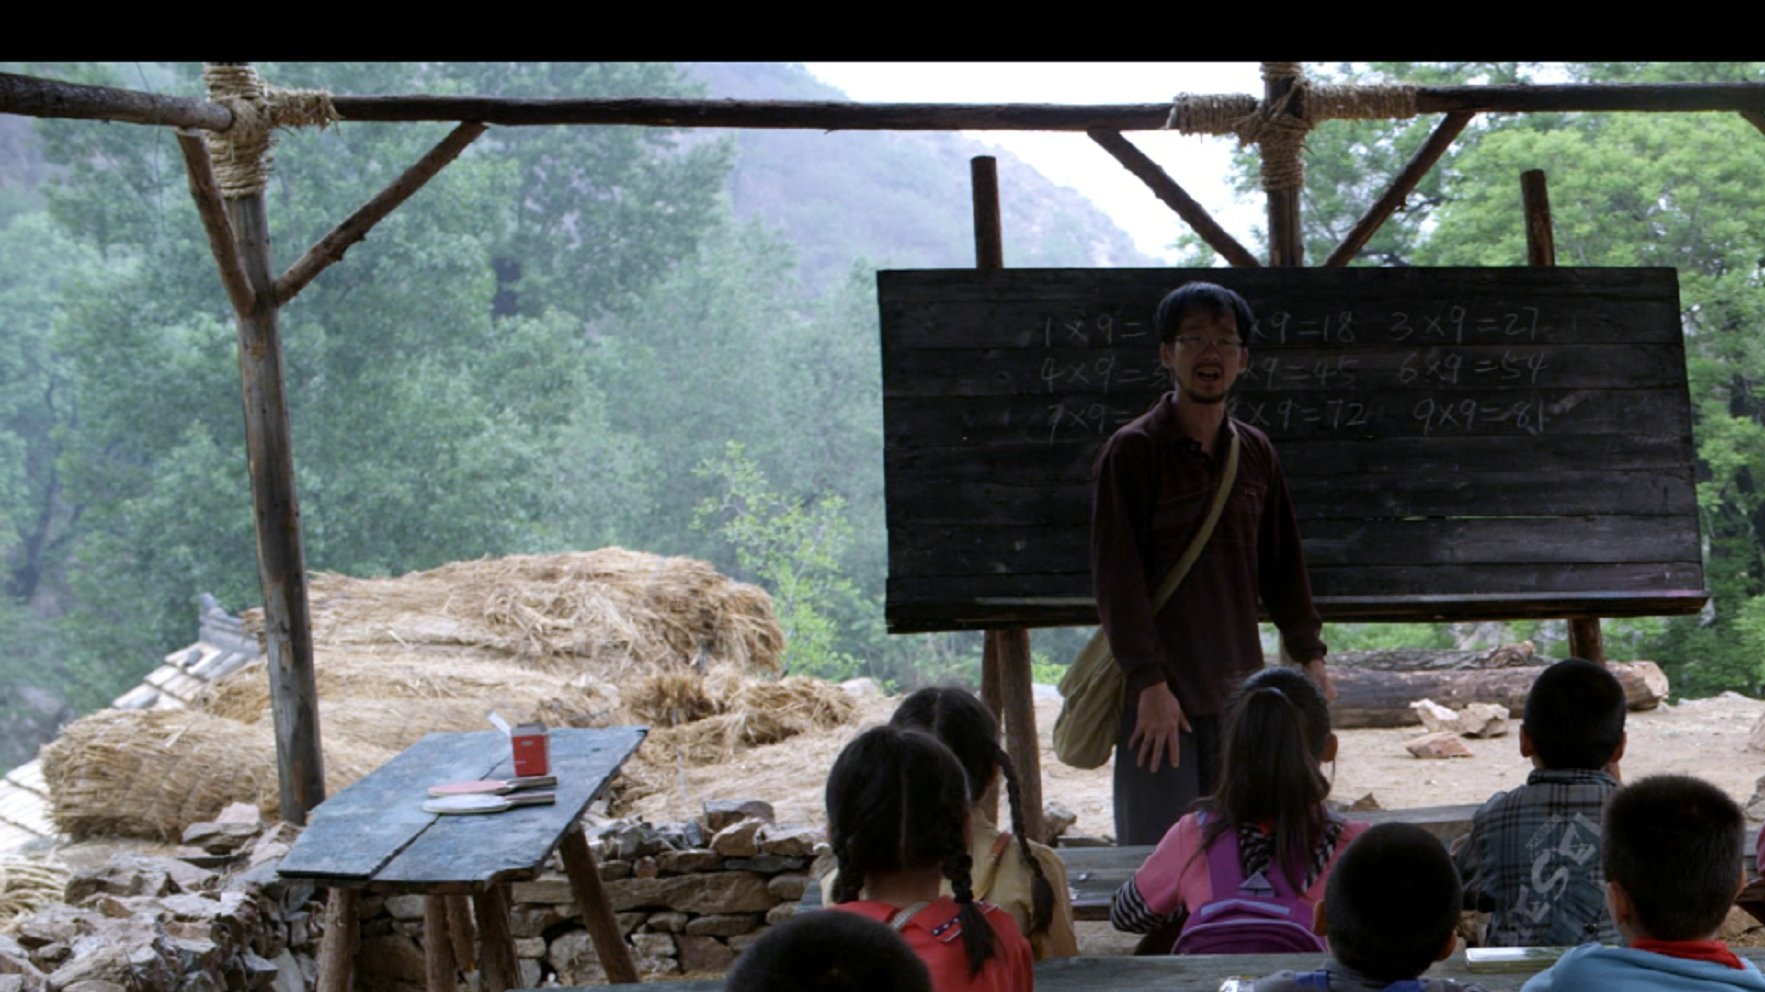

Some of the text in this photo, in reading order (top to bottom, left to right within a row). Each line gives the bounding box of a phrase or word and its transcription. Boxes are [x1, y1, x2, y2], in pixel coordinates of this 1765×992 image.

[1045, 311, 1147, 348] 1×9=
[1250, 311, 1357, 344] ×9=18
[1040, 354, 1168, 395] 4×9=3
[1243, 354, 1359, 390] ×9=45
